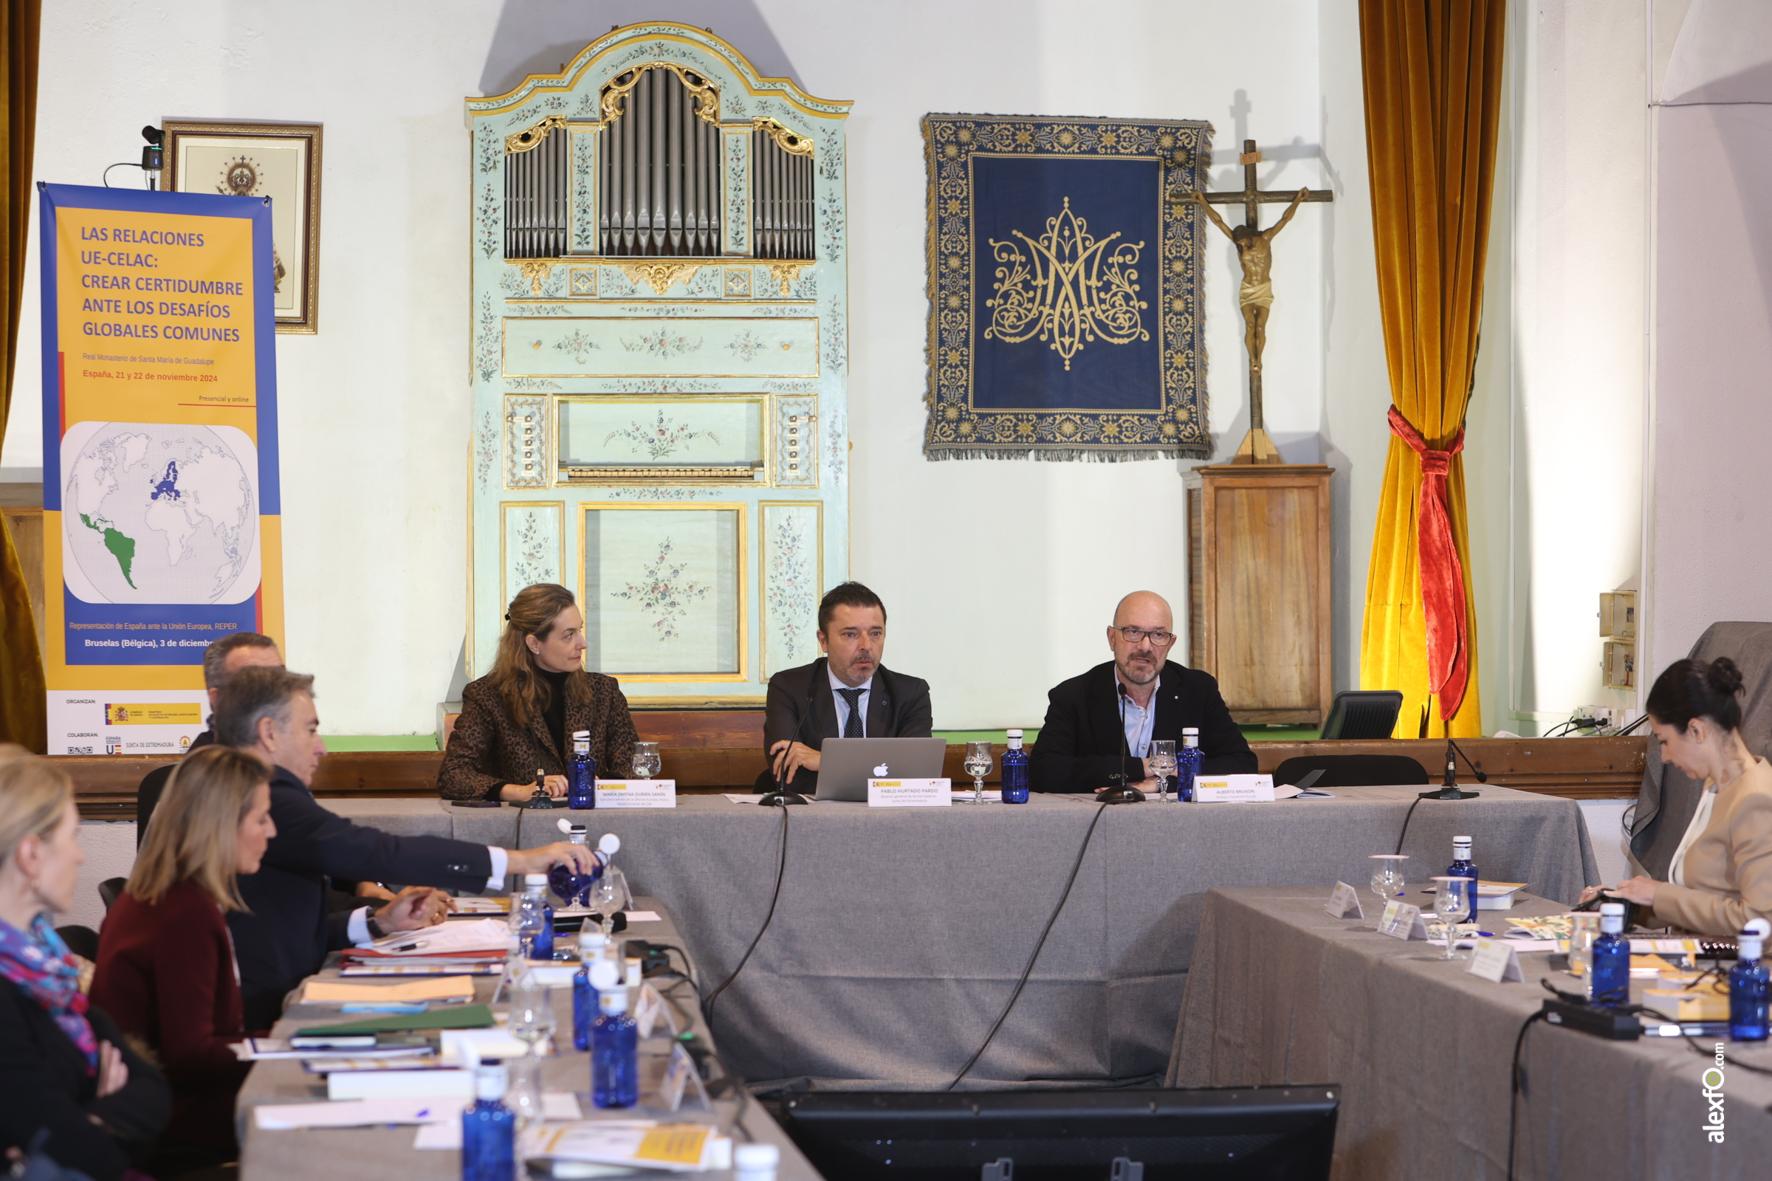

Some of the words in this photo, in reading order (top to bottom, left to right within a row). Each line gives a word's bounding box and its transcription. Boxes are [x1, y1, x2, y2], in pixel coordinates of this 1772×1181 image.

[81, 226, 109, 241] LAS
[113, 228, 205, 247] RELACIONES
[81, 251, 159, 268] UE-CELAC:
[81, 274, 131, 290] CREAR
[135, 277, 243, 296] CERTIDUMBRE
[82, 298, 122, 314] ANTE
[126, 300, 155, 316] LOS
[159, 301, 231, 319] DESAFÍOS
[83, 322, 159, 339] GLOBALES
[163, 325, 240, 343] COMUNES
[82, 369, 114, 380] España,
[115, 371, 125, 379] 21
[127, 372, 132, 381] y
[133, 372, 143, 380] 22
[144, 372, 156, 380] de
[157, 374, 199, 382] noviembre
[199, 374, 218, 383] 2024
[124, 622, 147, 632] España
[84, 638, 120, 648] Bruselas
[121, 638, 159, 649] (Bélgica),
[159, 639, 166, 648] 3
[166, 639, 178, 648] de
